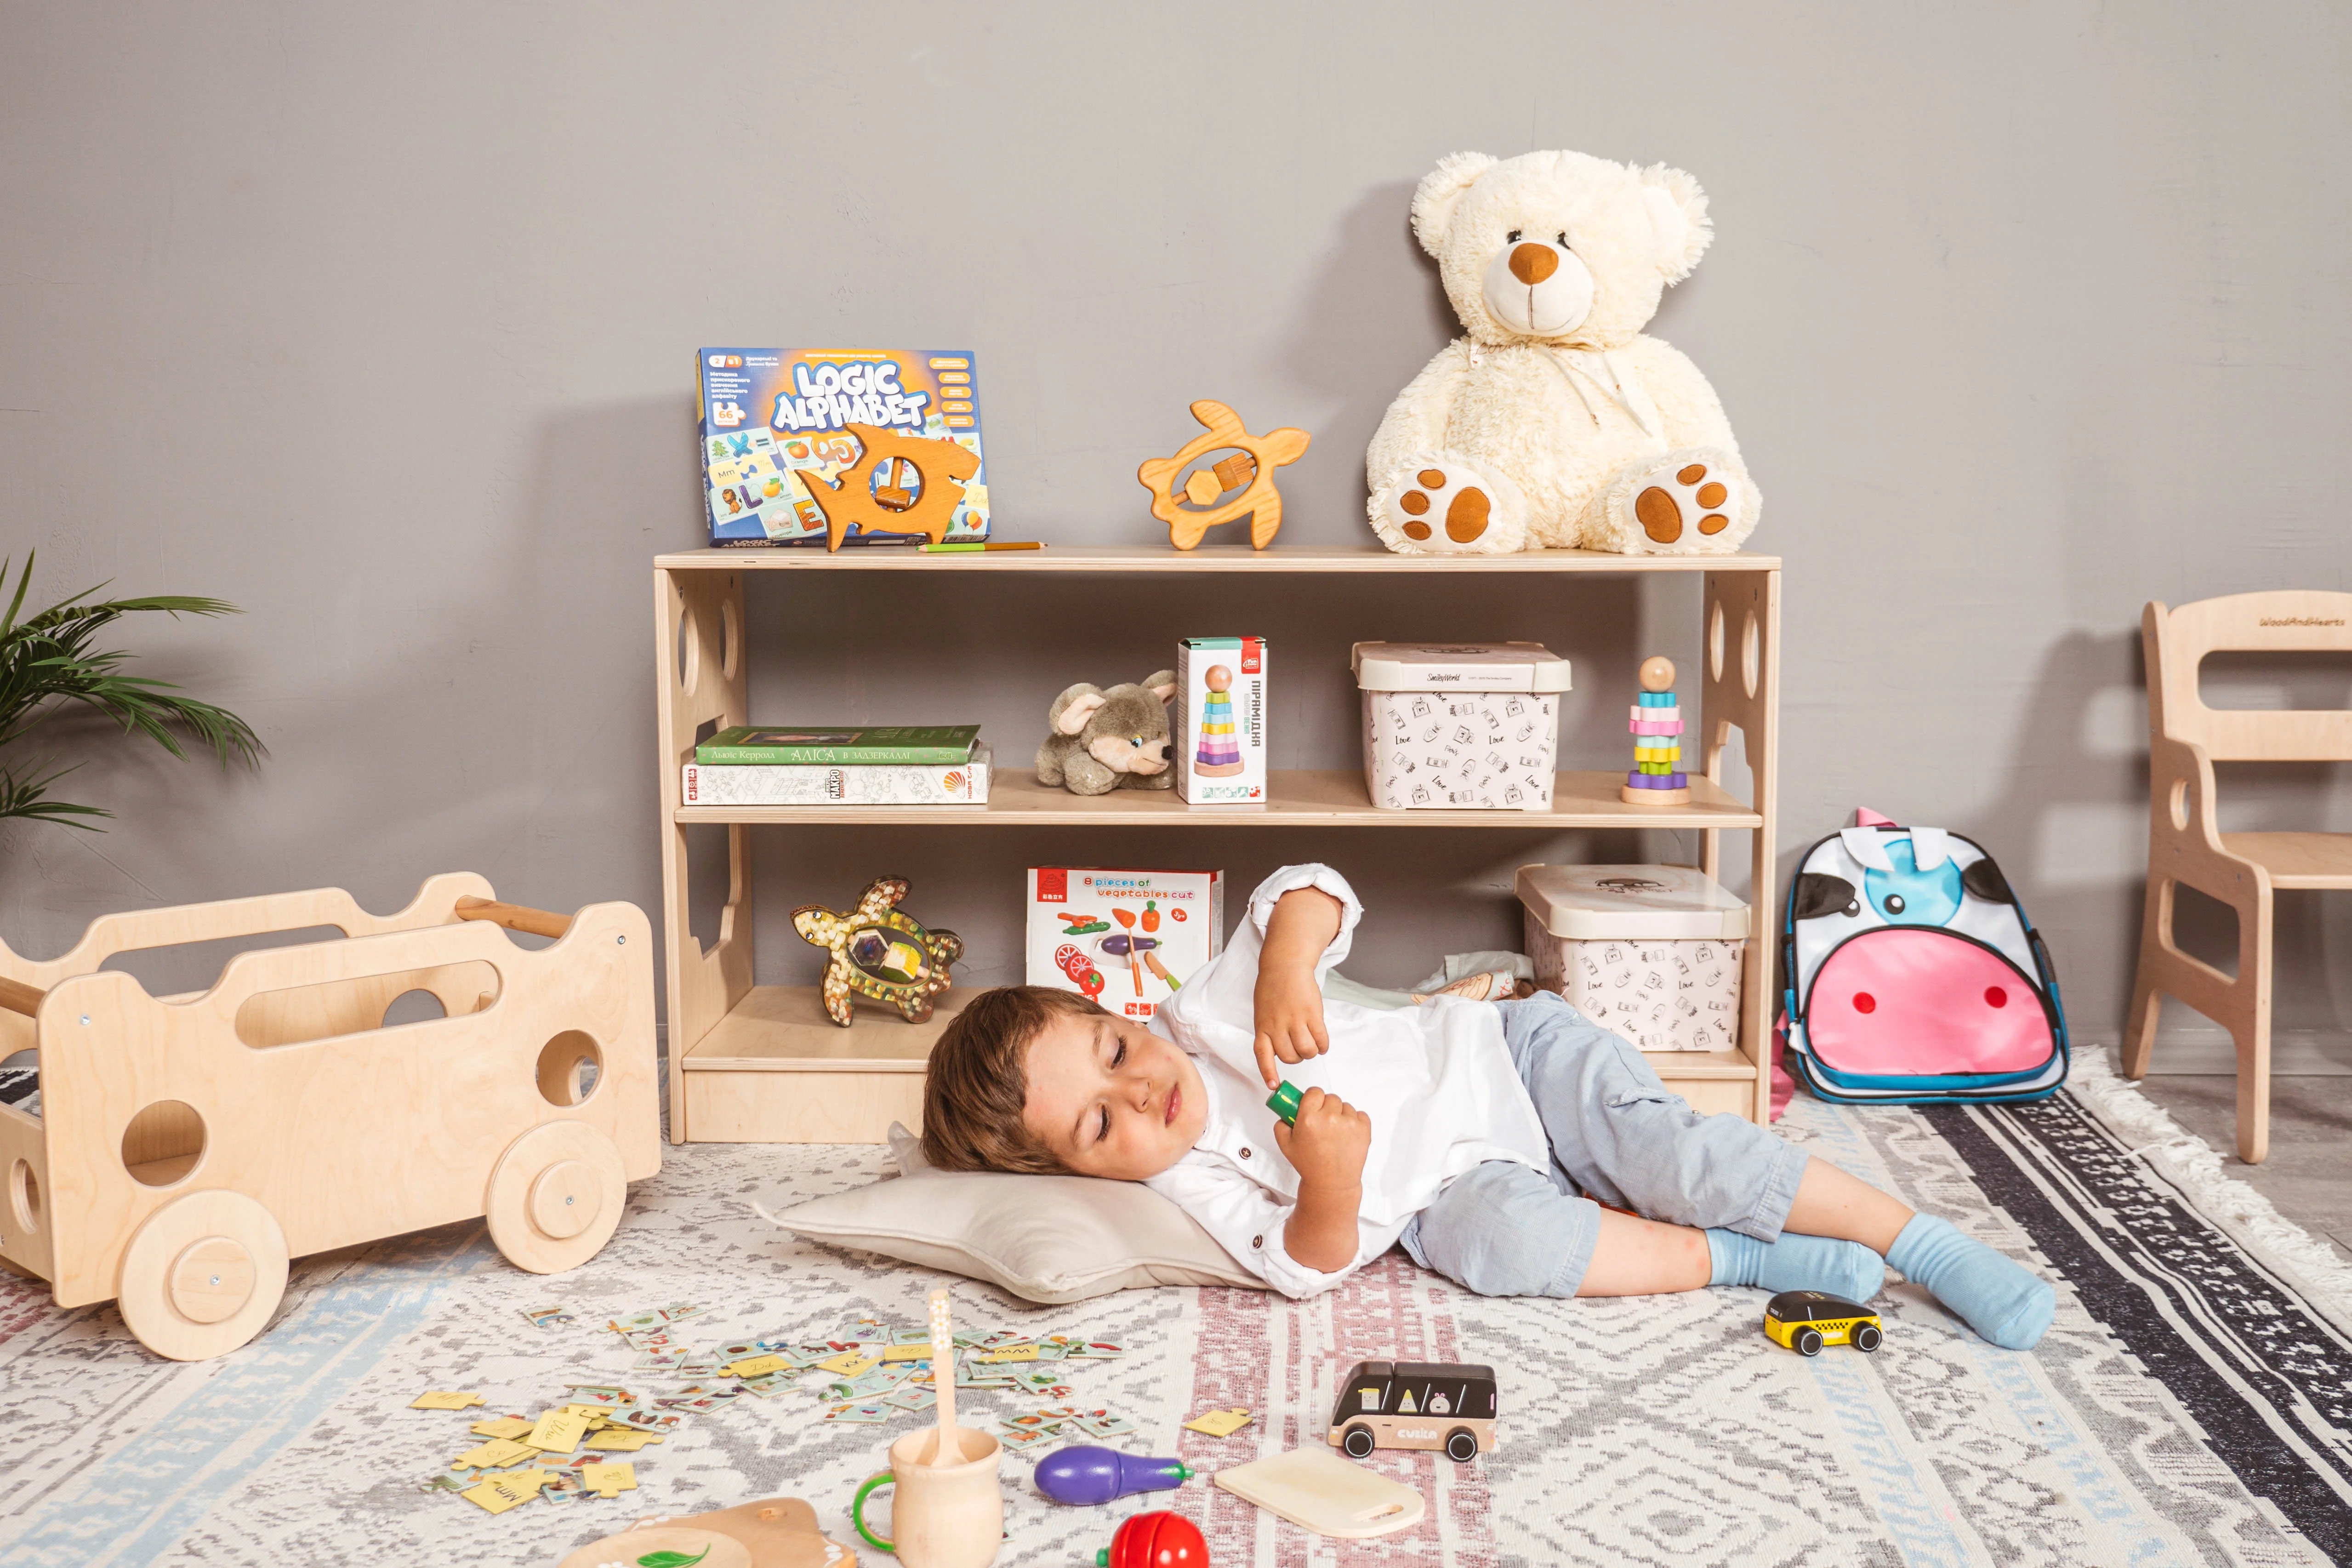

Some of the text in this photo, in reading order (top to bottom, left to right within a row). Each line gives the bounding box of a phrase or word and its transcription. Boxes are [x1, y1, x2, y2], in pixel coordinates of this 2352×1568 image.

[797, 364, 900, 397] LOGIC
[719, 411, 733, 419] 66
[774, 394, 927, 430] ALPHABET
[718, 469, 735, 479] Mm
[1427, 673, 1461, 683] SmileyWorld
[1251, 680, 1261, 747] ПІРАМІДКА
[1395, 736, 1412, 745] Love
[1489, 735, 1504, 744] Love
[740, 751, 775, 761] Керролл
[791, 749, 836, 761] АЛІСА
[830, 770, 840, 799] МАКРО
[1432, 775, 1447, 790] Love
[1525, 775, 1540, 789] Love
[1084, 877, 1150, 887] 8 pieces of
[1098, 889, 1168, 898] vegetables
[1588, 981, 1603, 990] Love
[1679, 981, 1694, 990] Love
[1623, 1020, 1637, 1033] Love
[1713, 1018, 1727, 1032] Love
